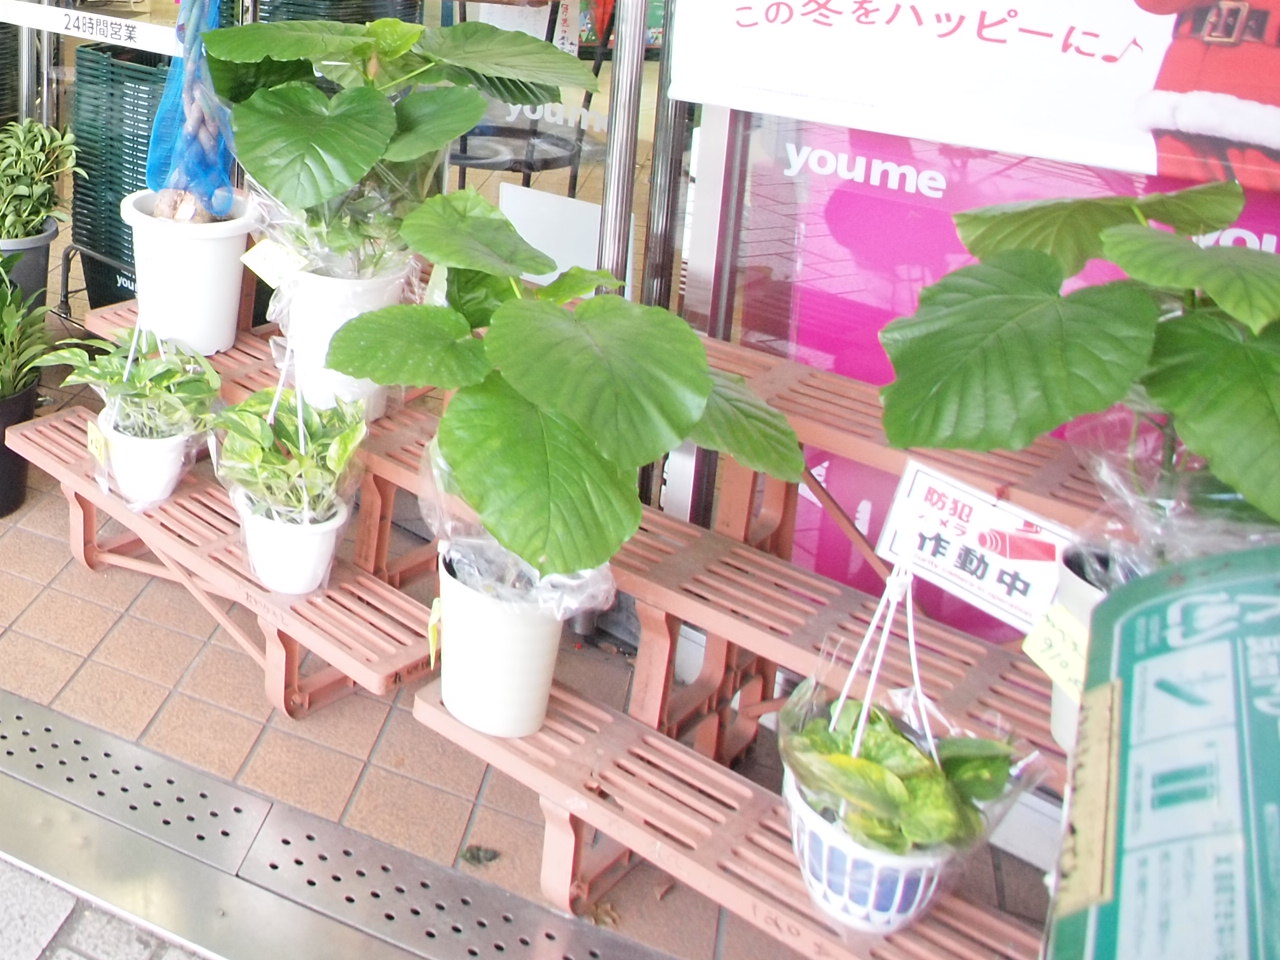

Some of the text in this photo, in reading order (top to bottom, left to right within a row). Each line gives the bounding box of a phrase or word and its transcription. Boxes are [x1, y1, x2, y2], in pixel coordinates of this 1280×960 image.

[63, 13, 138, 44] 24時間営業
[506, 103, 608, 132] youm
[783, 141, 948, 200] youme
[116, 274, 138, 292] you
[924, 485, 974, 524] 防犯
[917, 531, 1032, 599] 作動中
